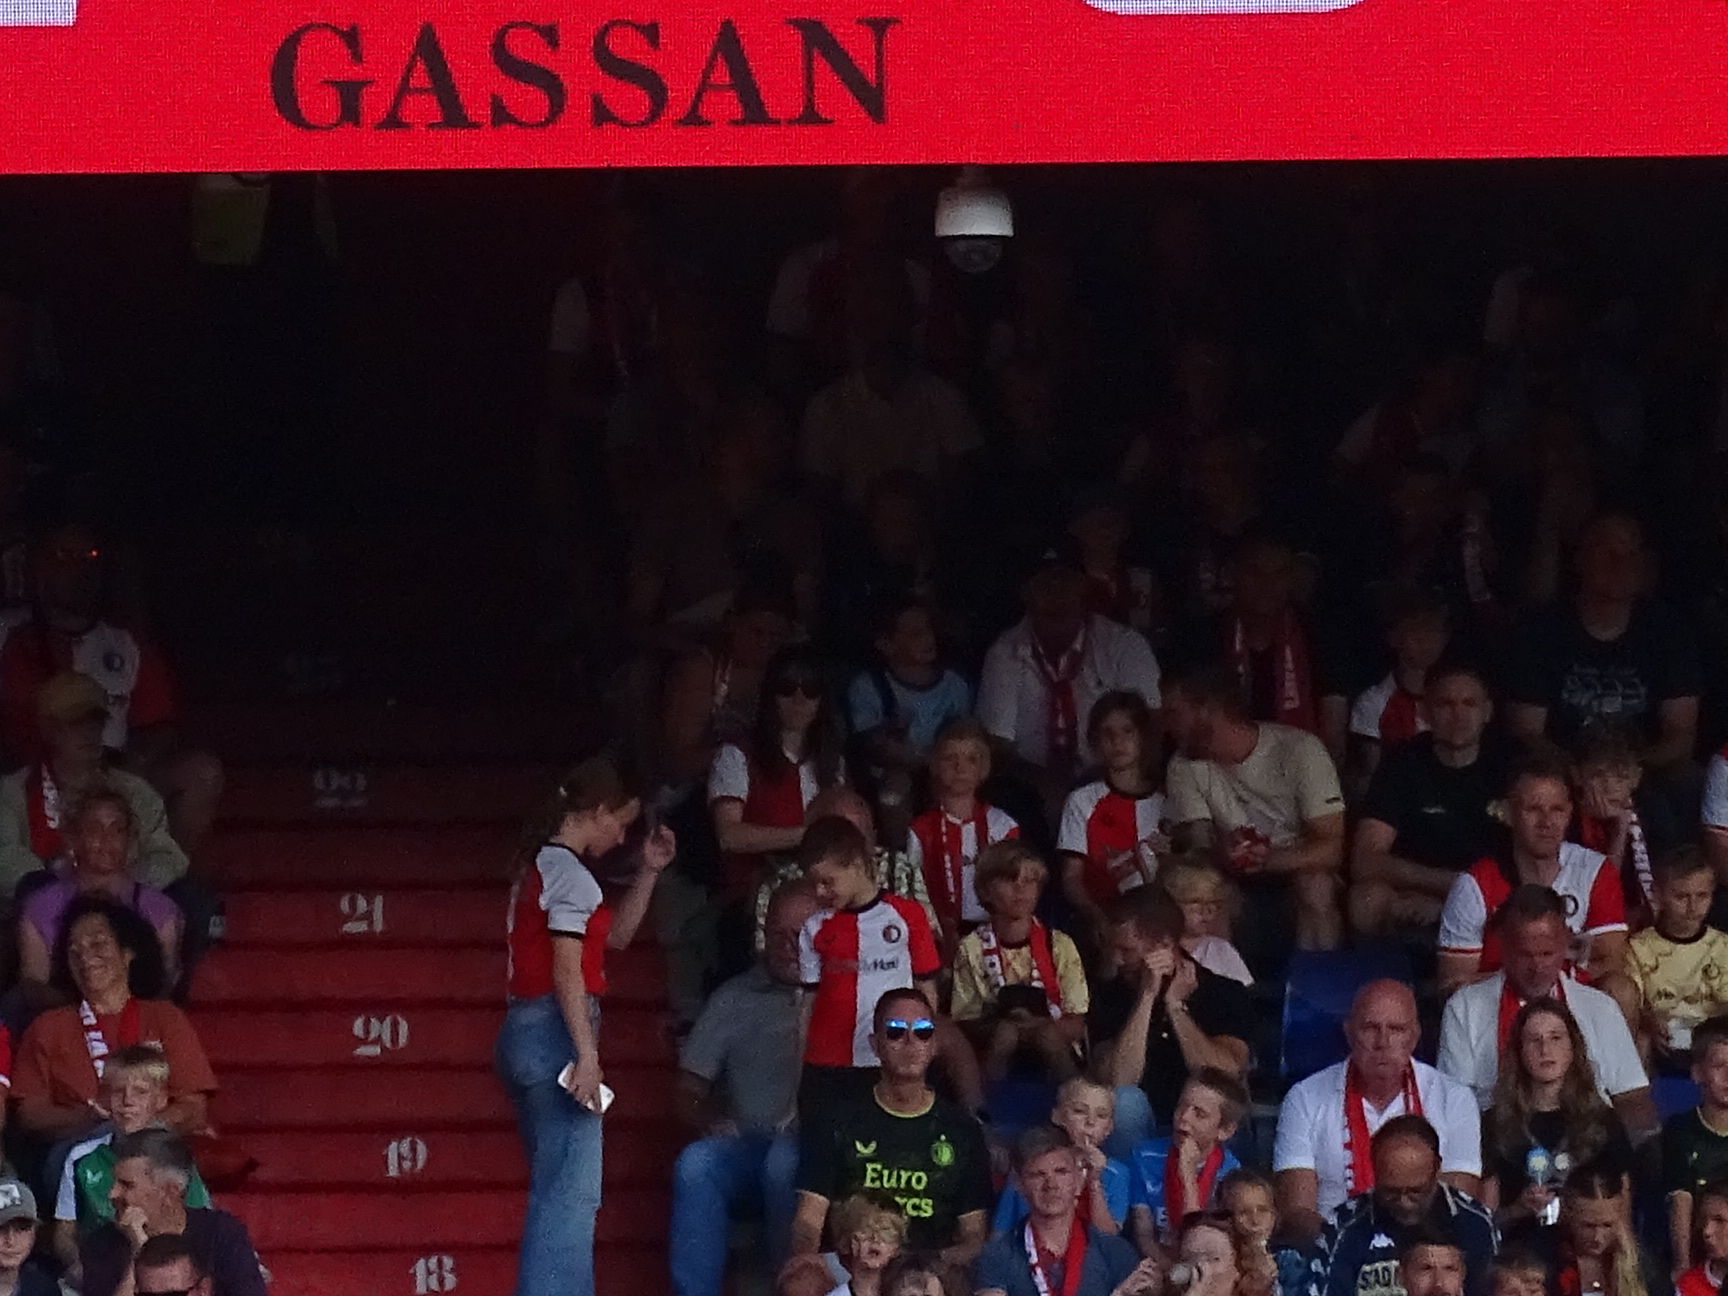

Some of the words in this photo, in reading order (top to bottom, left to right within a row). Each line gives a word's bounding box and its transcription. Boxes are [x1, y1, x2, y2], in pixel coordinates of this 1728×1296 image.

[270, 16, 902, 132] GASSAN
[339, 893, 385, 934] 21
[351, 1013, 410, 1058] 20
[382, 1136, 429, 1178] 19
[863, 1160, 929, 1192] Euro
[408, 1254, 457, 1295] 18
